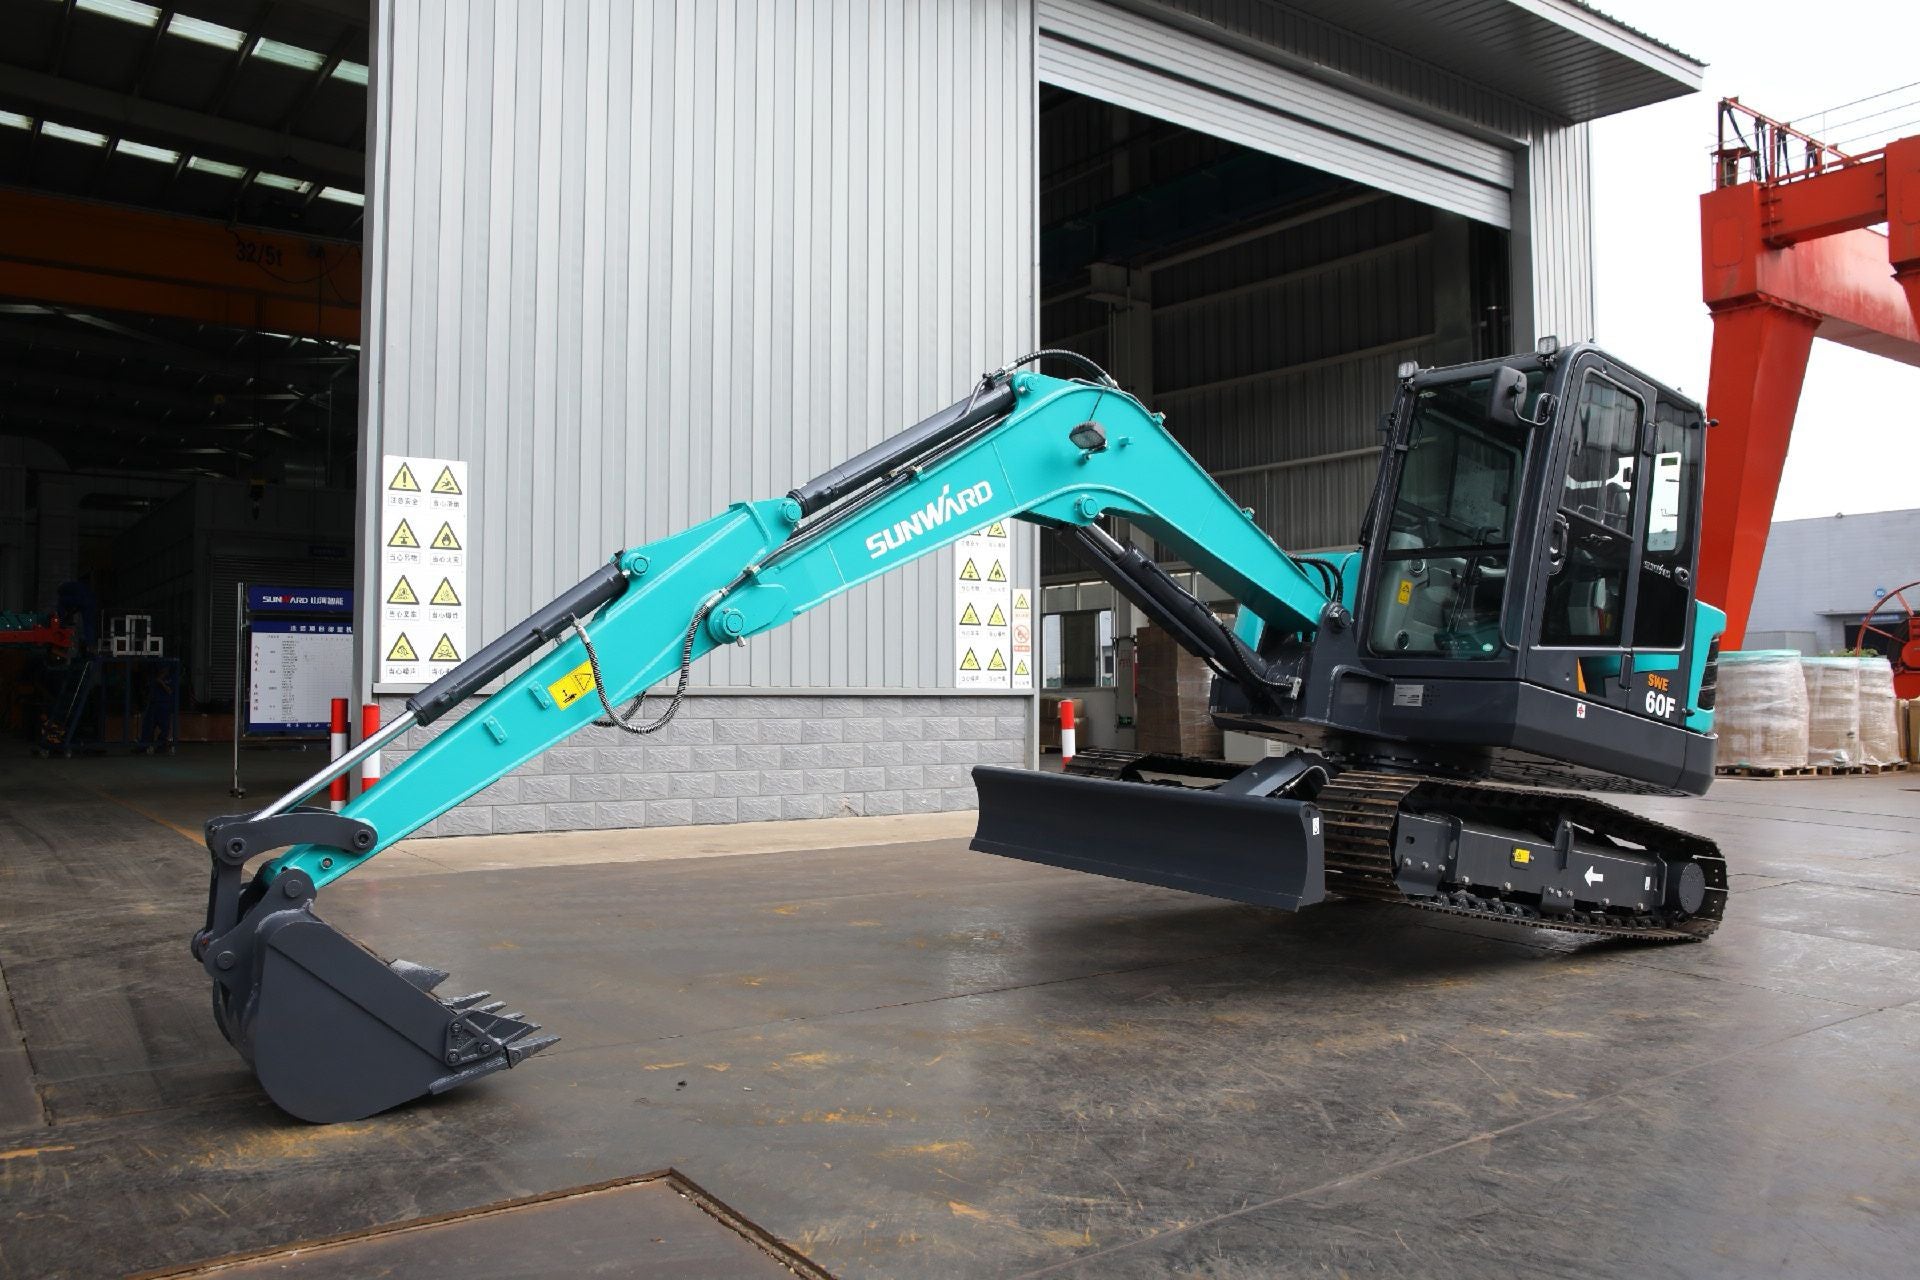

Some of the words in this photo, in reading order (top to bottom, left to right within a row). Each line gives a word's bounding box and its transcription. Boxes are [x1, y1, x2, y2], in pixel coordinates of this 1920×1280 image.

[237, 240, 283, 266] 32/5t
[865, 480, 993, 559] SUNWARD
[262, 594, 308, 604] SUNWARD
[1647, 673, 1670, 692] SWE
[1645, 690, 1676, 719] 60F
